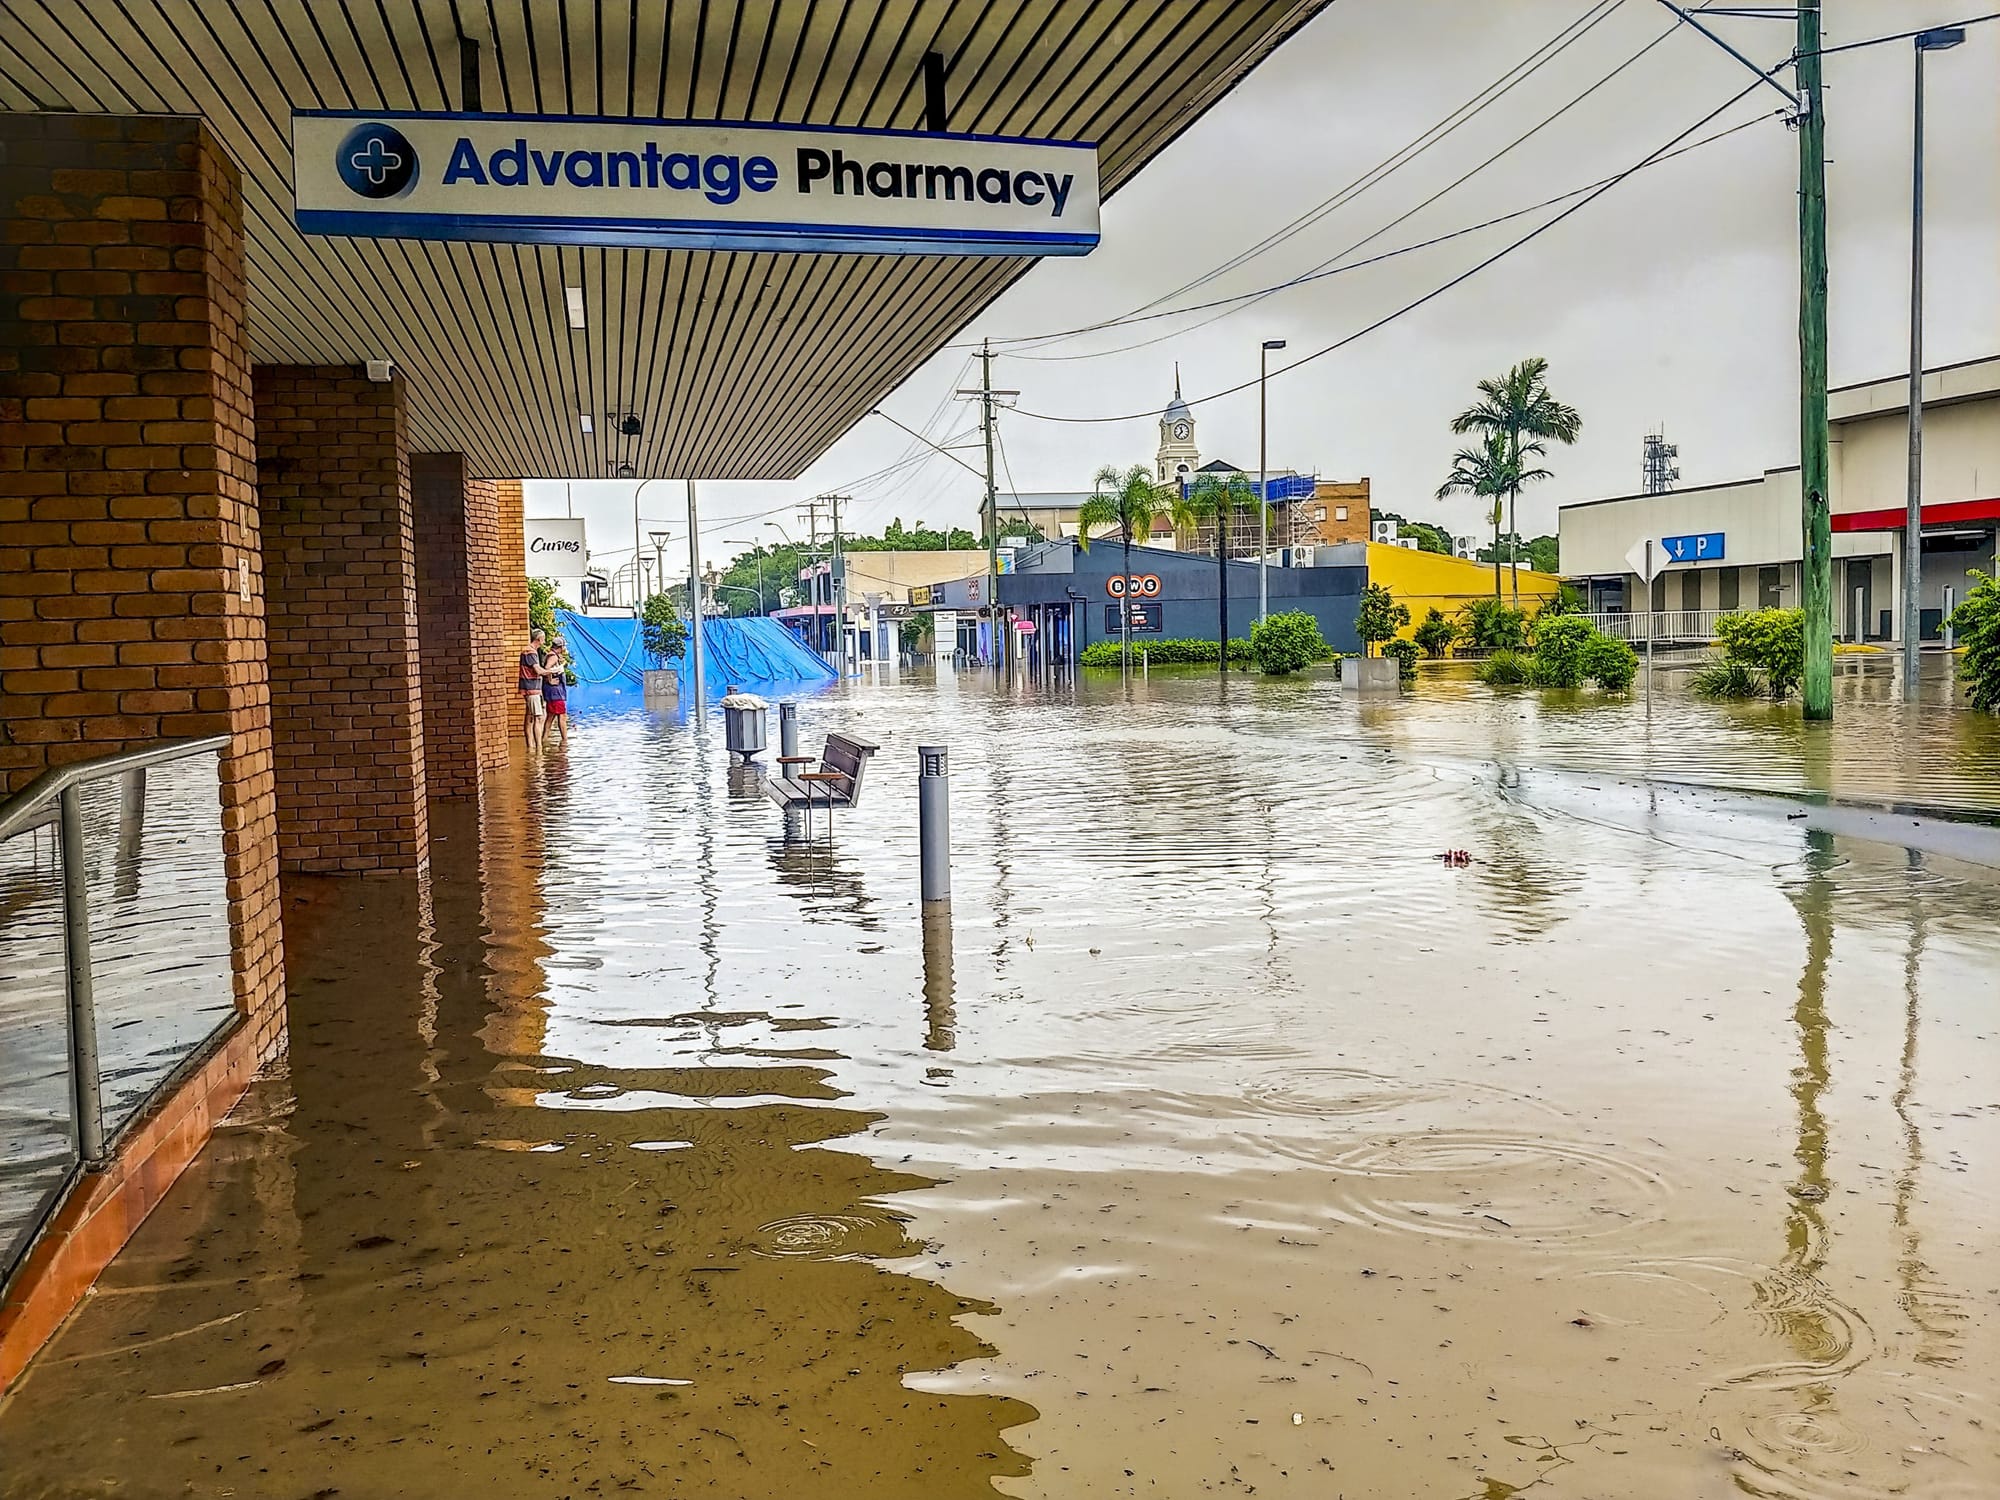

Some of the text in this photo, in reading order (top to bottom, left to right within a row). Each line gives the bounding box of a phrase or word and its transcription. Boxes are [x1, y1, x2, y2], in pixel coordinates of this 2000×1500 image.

[442, 137, 1074, 217] Advantage Pharmacy
[530, 537, 580, 553] Curves
[1697, 537, 1707, 557] P
